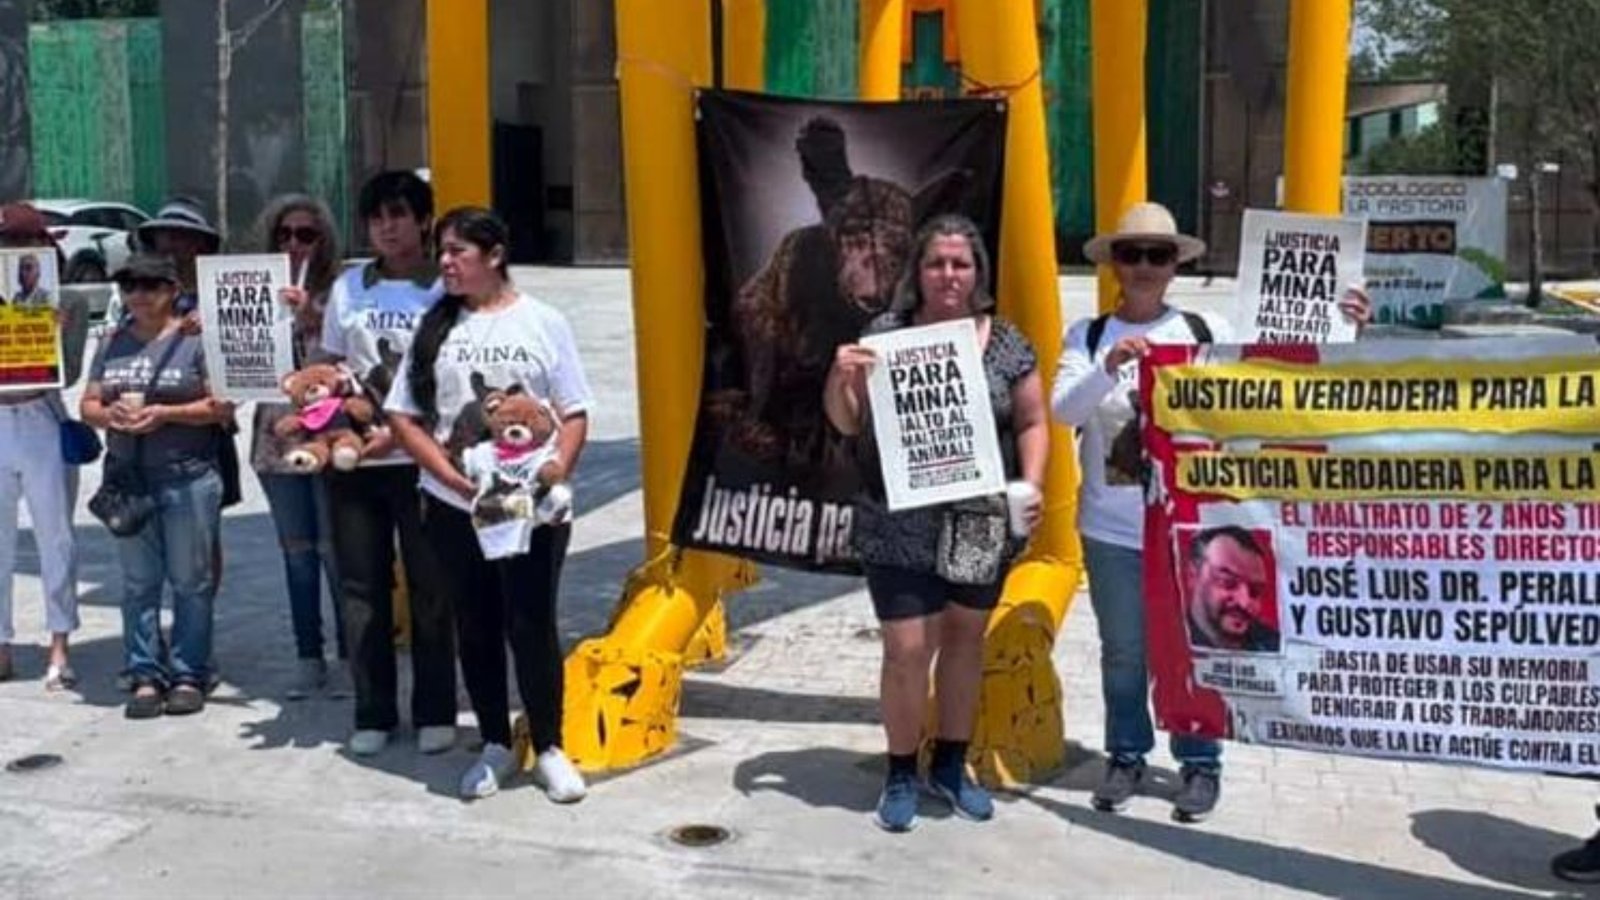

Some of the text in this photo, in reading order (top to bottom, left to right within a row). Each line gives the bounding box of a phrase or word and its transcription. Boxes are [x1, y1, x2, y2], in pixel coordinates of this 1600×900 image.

[1348, 199, 1467, 214] LA PASTORA
[1262, 248, 1337, 277] PARA
[215, 285, 272, 306] PARA
[1260, 273, 1337, 302] MINA!
[217, 306, 274, 328] MINA!
[364, 310, 414, 330] MIN
[1259, 298, 1331, 320] ¡ALTO AL
[1255, 314, 1332, 335] MALTRATO
[456, 344, 529, 364] MINA
[890, 358, 963, 391] PARA
[893, 382, 969, 416] MINA!
[1167, 374, 1596, 412] JUSTICIA VERDADERA PARA LA
[948, 409, 968, 425] AL
[901, 424, 974, 448] MALTRATO
[907, 439, 974, 464] ANIMAL!
[1186, 456, 1596, 491] JUSTICIA VERDADERA PARA LA
[692, 474, 856, 565] Justicia pa
[1280, 501, 1306, 527] EL
[1311, 501, 1431, 530] MALTRATO
[1439, 502, 1469, 530] DE
[1477, 502, 1494, 530] 2
[1501, 498, 1566, 530] AÑOS
[1307, 531, 1486, 561] RESPONSABLES
[1289, 560, 1600, 605] JOSÉ LUIS DR. PERAL
[1290, 603, 1600, 647] Y GUSTAVO SEPÚLVED
[1319, 650, 1589, 682] ¡BASTA DE USAR SU MEMORIA
[1297, 671, 1343, 694] PARA
[1348, 674, 1438, 700] PROTEGER
[1443, 680, 1455, 700] A
[1461, 680, 1495, 703] LOS
[1501, 683, 1600, 707] CULPABLES
[1311, 695, 1397, 720] DENIGRAR
[1402, 702, 1414, 723] A
[1420, 702, 1454, 724] LOS
[1350, 727, 1382, 749] QUE
[1386, 730, 1408, 751] LA
[1413, 731, 1443, 754] LEY
[1449, 732, 1503, 760] ACTÚE
[1509, 738, 1572, 764] CONTRA
[1577, 742, 1600, 766] EL
